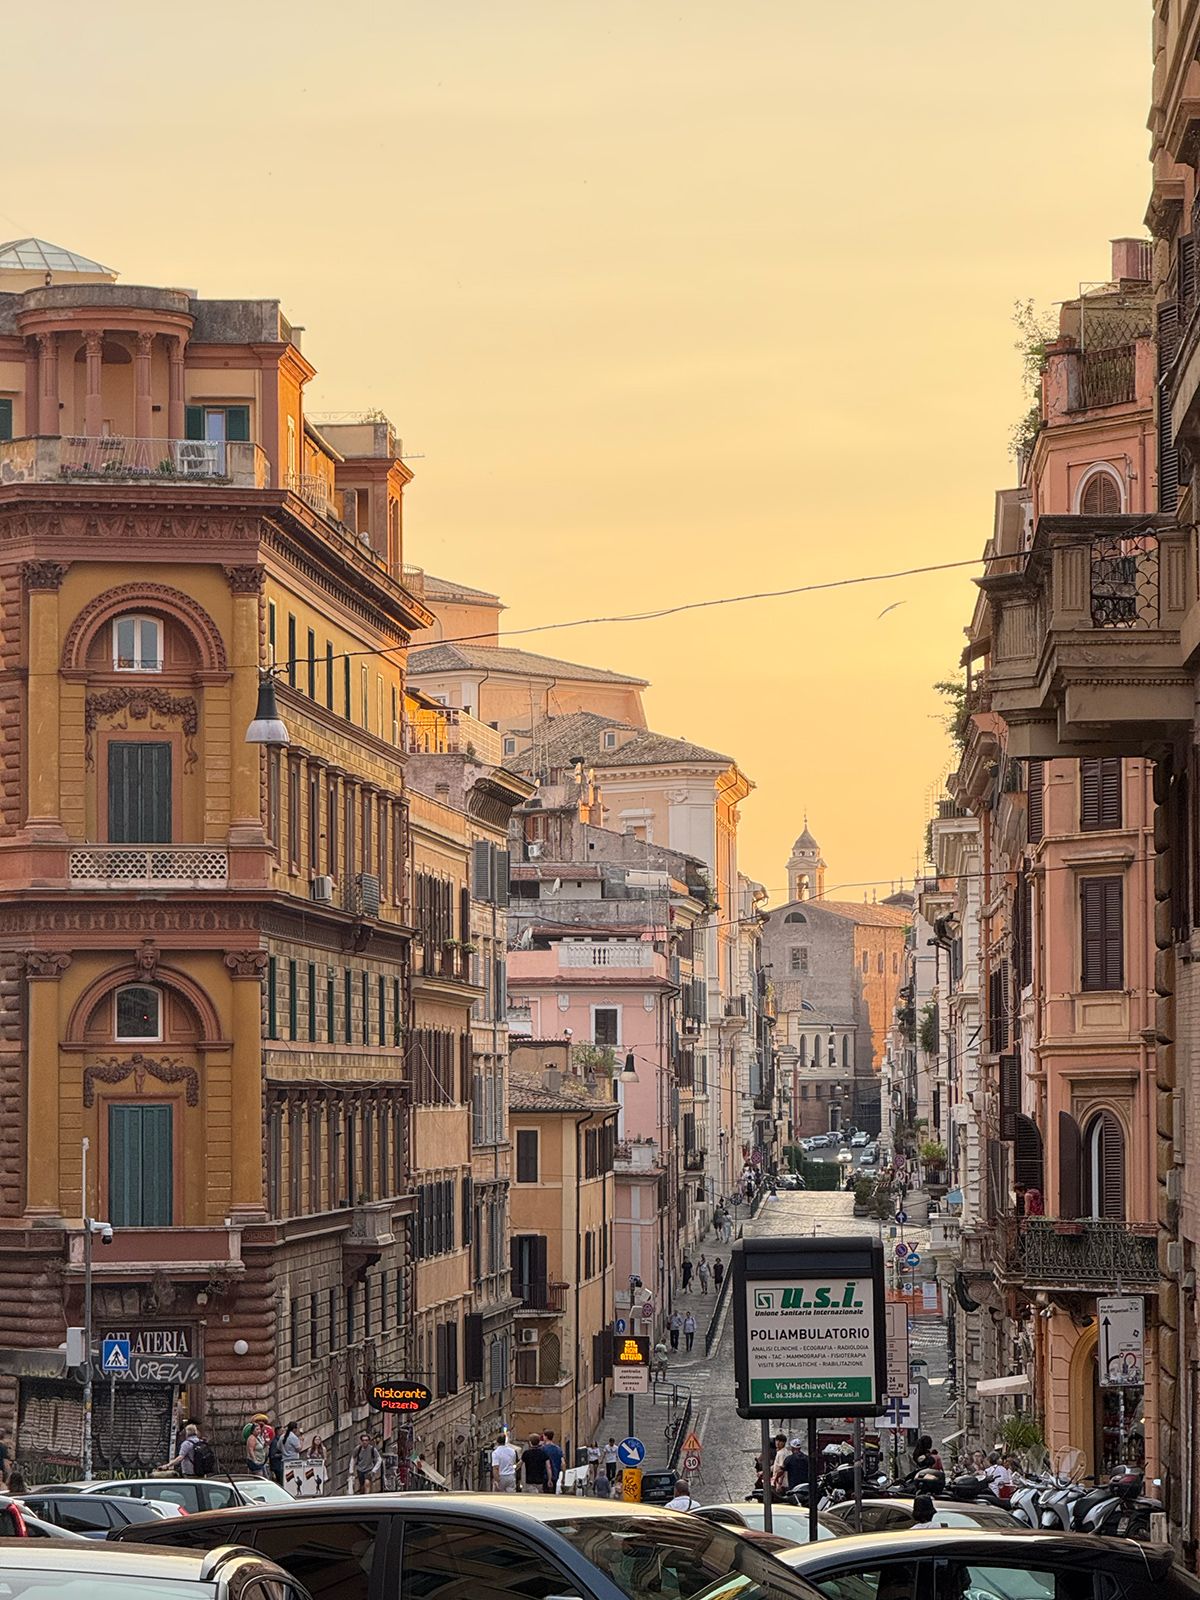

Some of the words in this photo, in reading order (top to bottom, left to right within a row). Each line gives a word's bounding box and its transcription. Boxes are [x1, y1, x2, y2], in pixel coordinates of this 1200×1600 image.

[780, 1282, 863, 1308] u.s.i.
[750, 1328, 870, 1340] POLIAMBULATORIO
[789, 1382, 836, 1390] Machiavelli,
[373, 1387, 427, 1399] Ristorante
[381, 1400, 419, 1410] Pizzeria
[687, 1459, 696, 1467] 30
